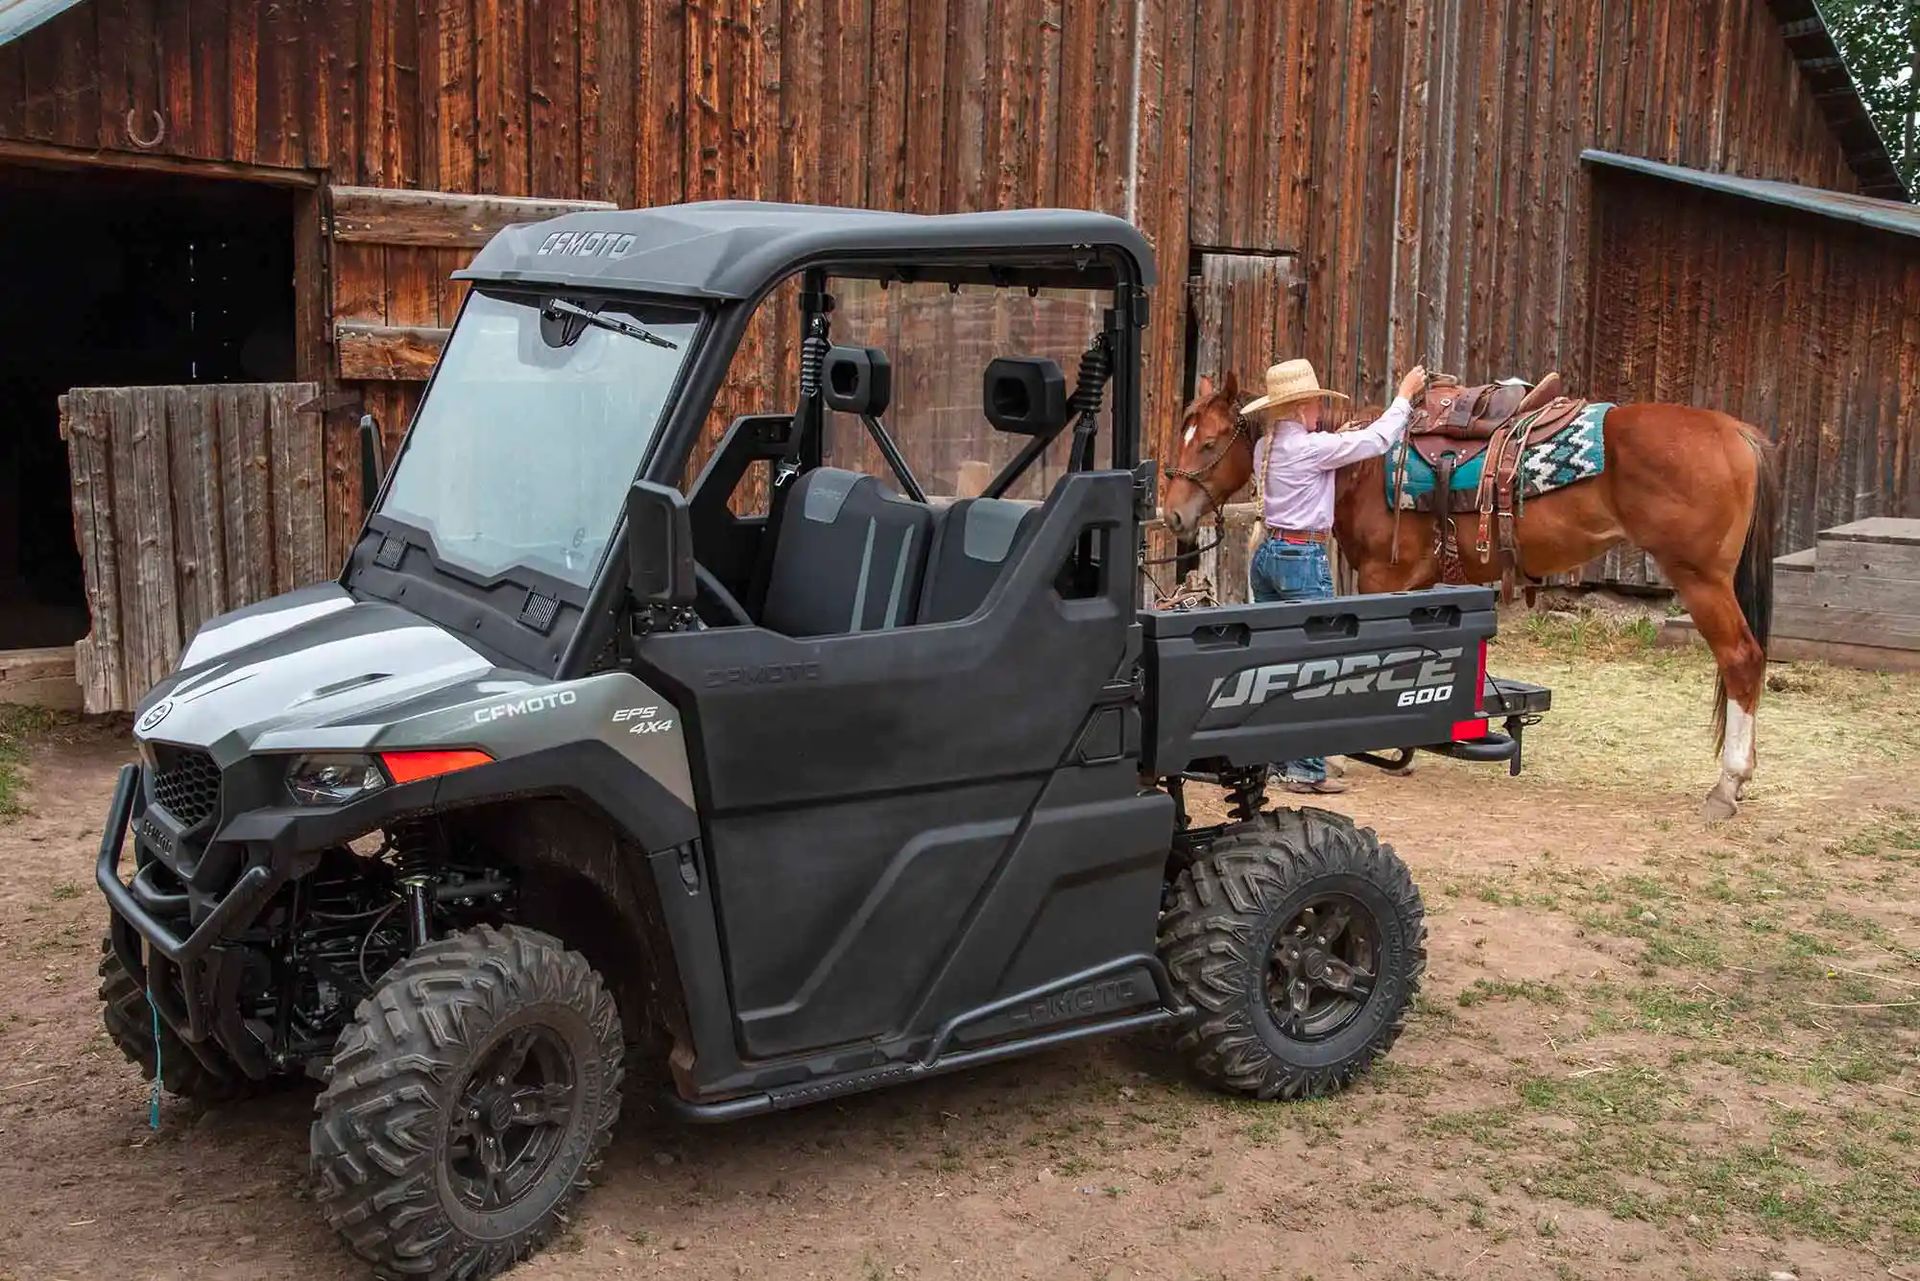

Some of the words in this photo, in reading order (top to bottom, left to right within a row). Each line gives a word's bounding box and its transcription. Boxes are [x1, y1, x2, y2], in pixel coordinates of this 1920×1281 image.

[538, 231, 639, 260] CFMOTO
[1206, 647, 1463, 708] UFORCE
[473, 690, 577, 723] CFMOTO
[1397, 685, 1454, 707] 600
[611, 706, 659, 722] EPS
